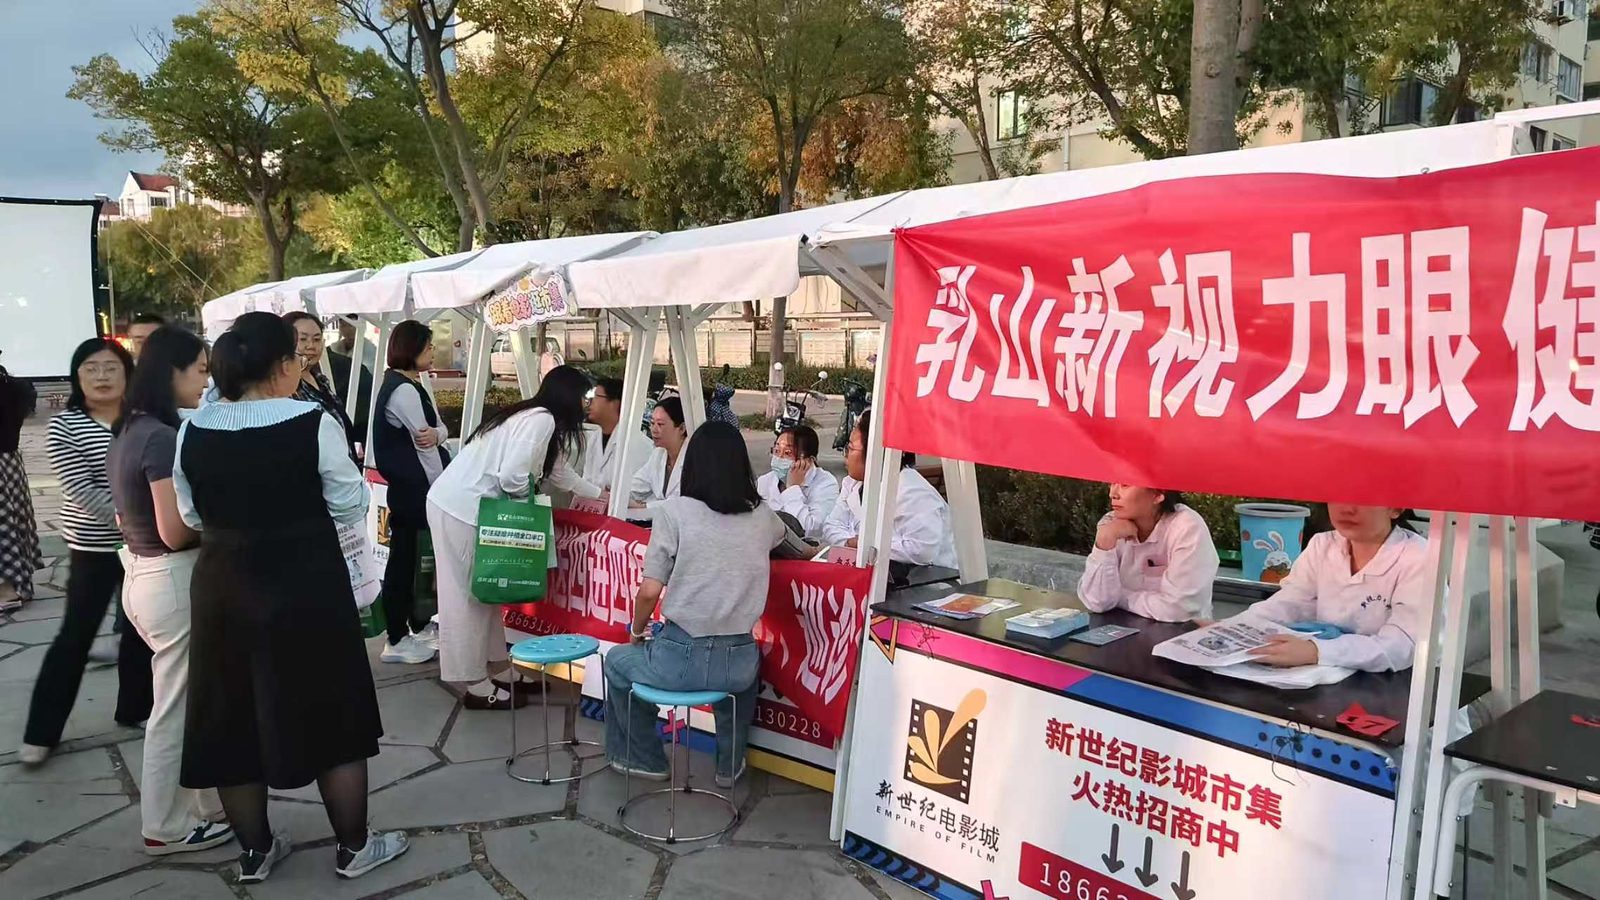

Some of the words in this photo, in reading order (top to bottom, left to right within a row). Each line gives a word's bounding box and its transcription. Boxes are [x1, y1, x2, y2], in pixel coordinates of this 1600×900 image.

[1045, 718, 1283, 830] 新世纪影城市集
[875, 779, 1001, 852] 新世纪电影城
[876, 806, 925, 832] EMPIRE
[935, 831, 952, 843] OF
[961, 843, 996, 864] FILM
[1071, 771, 1240, 858] 火热招商中
